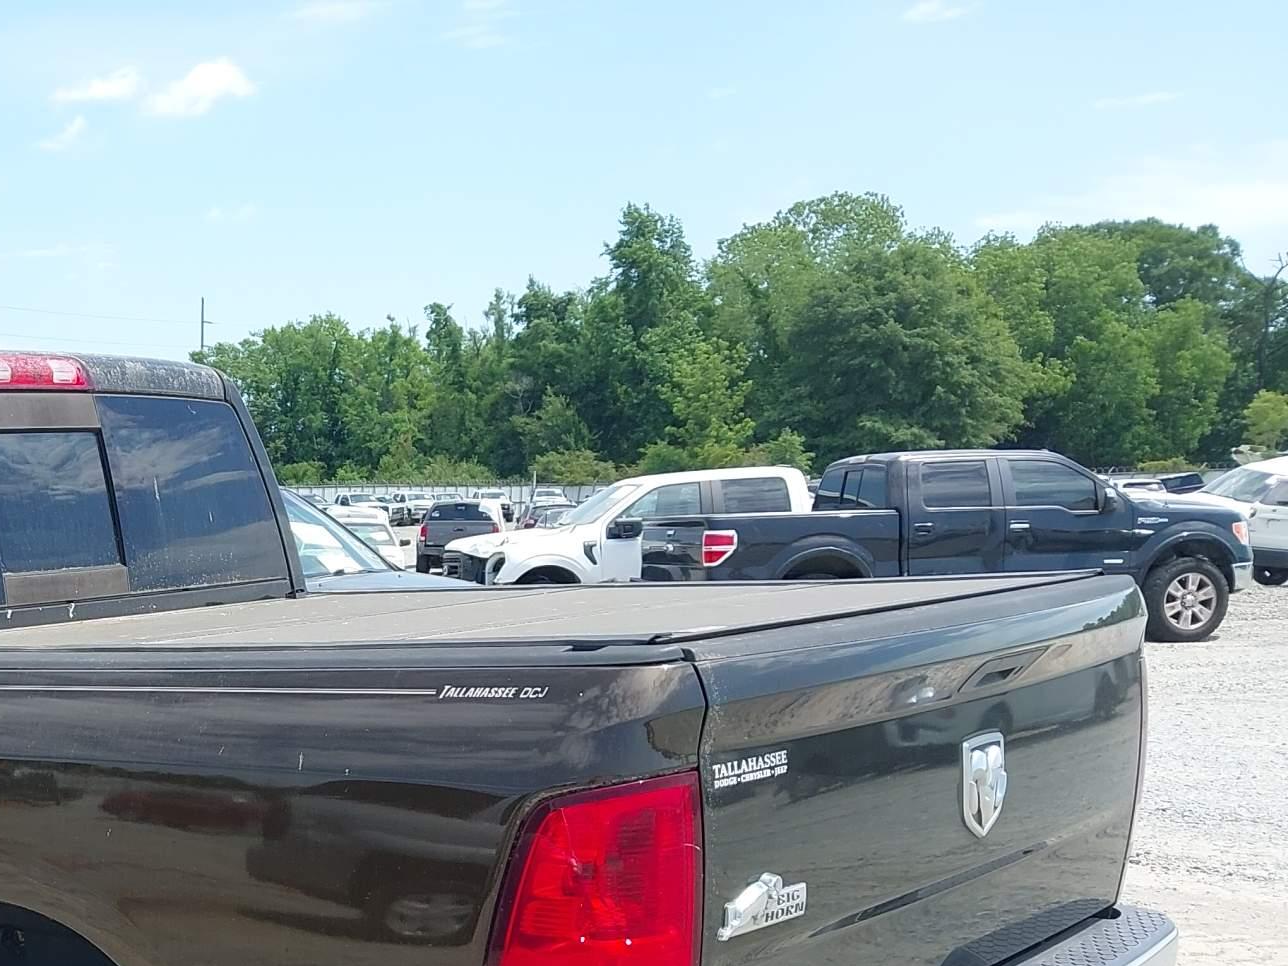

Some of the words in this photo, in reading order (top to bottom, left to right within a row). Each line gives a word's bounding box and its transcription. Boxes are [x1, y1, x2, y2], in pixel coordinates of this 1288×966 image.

[439, 685, 519, 699] TALLAHASSEE
[519, 686, 549, 699] DCJ
[712, 750, 788, 779] TALLAHASSEE
[777, 889, 801, 906] BIG
[764, 901, 804, 923] HORN
